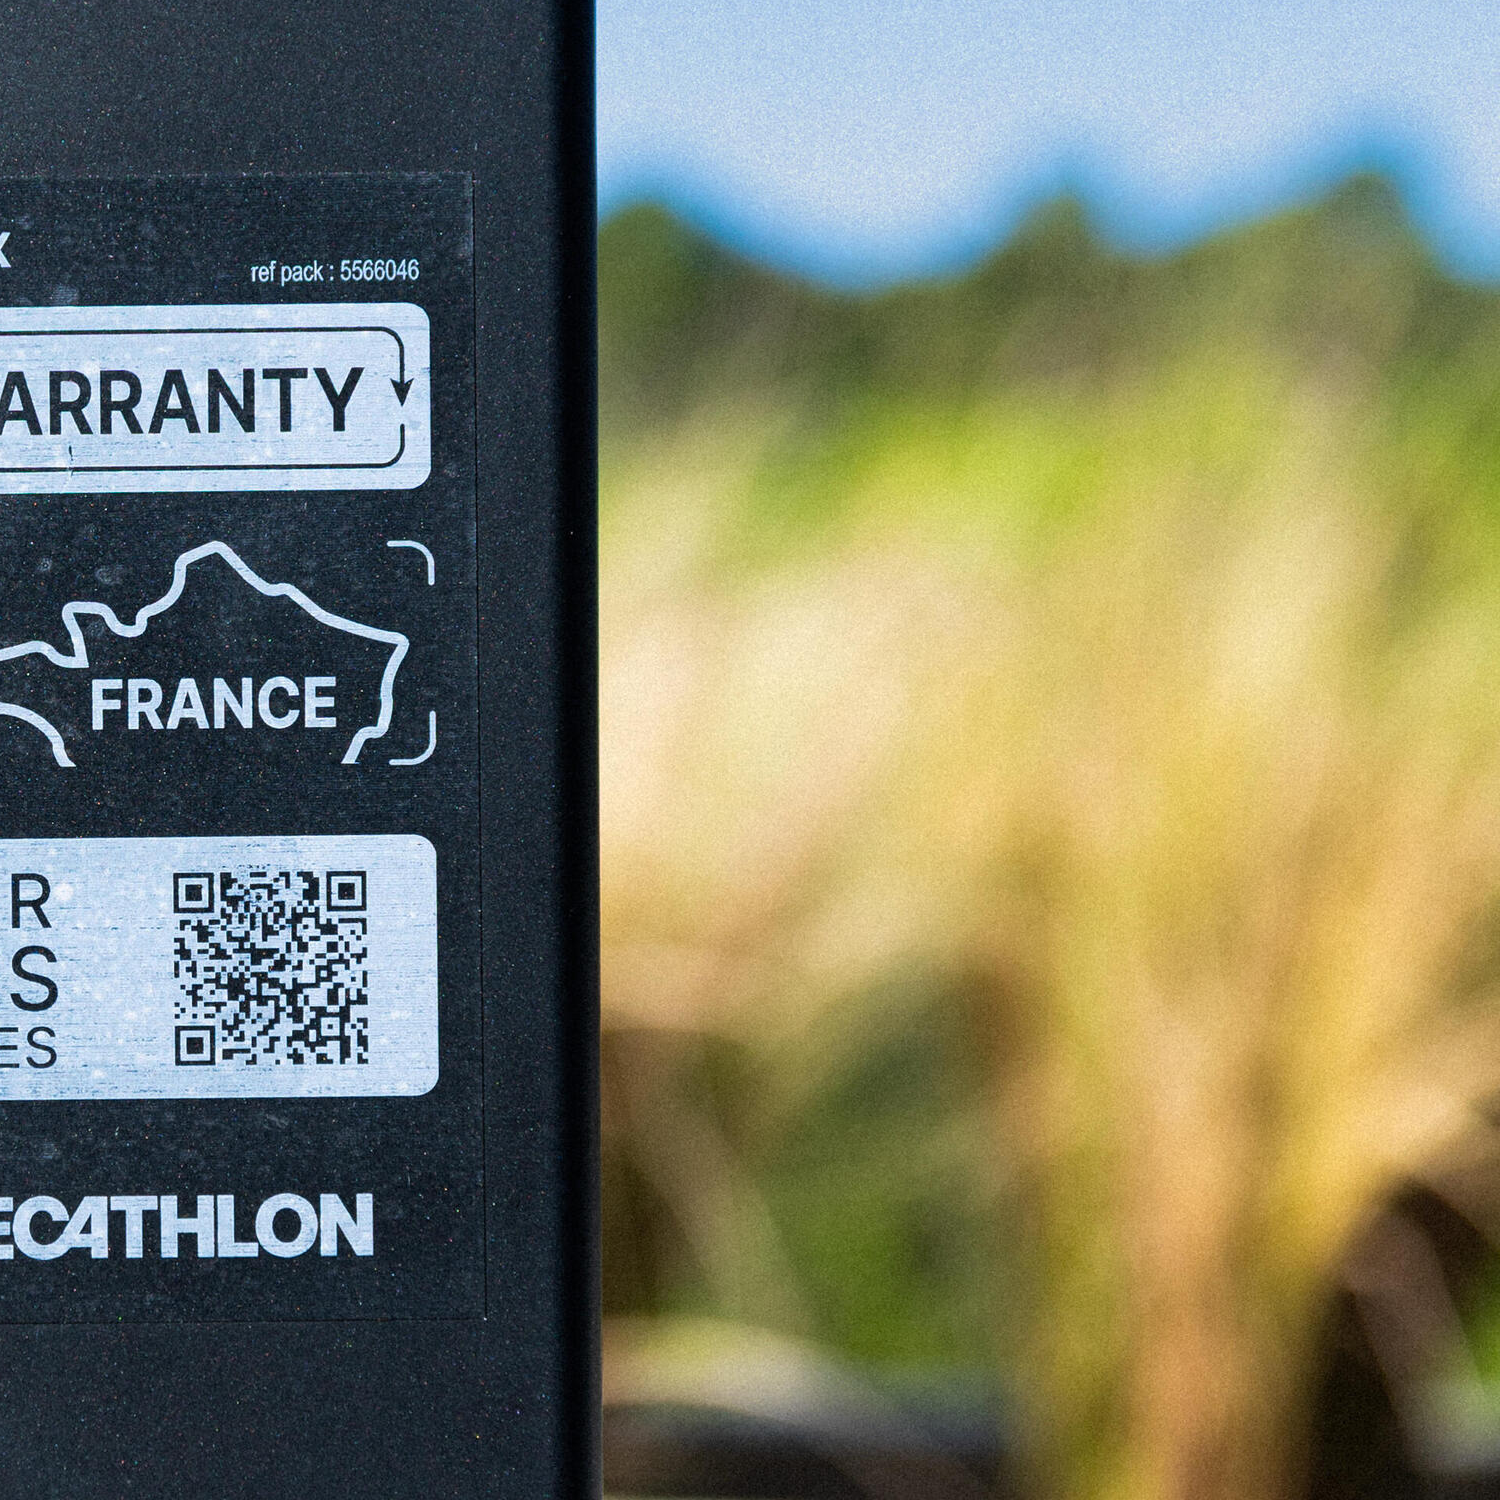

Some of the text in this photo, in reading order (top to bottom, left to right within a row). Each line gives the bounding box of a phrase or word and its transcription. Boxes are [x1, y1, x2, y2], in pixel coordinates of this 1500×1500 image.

[251, 260, 277, 282] ref
[281, 260, 324, 287] pack
[340, 259, 420, 281] 5566046
[91, 676, 338, 731] FRANCE
